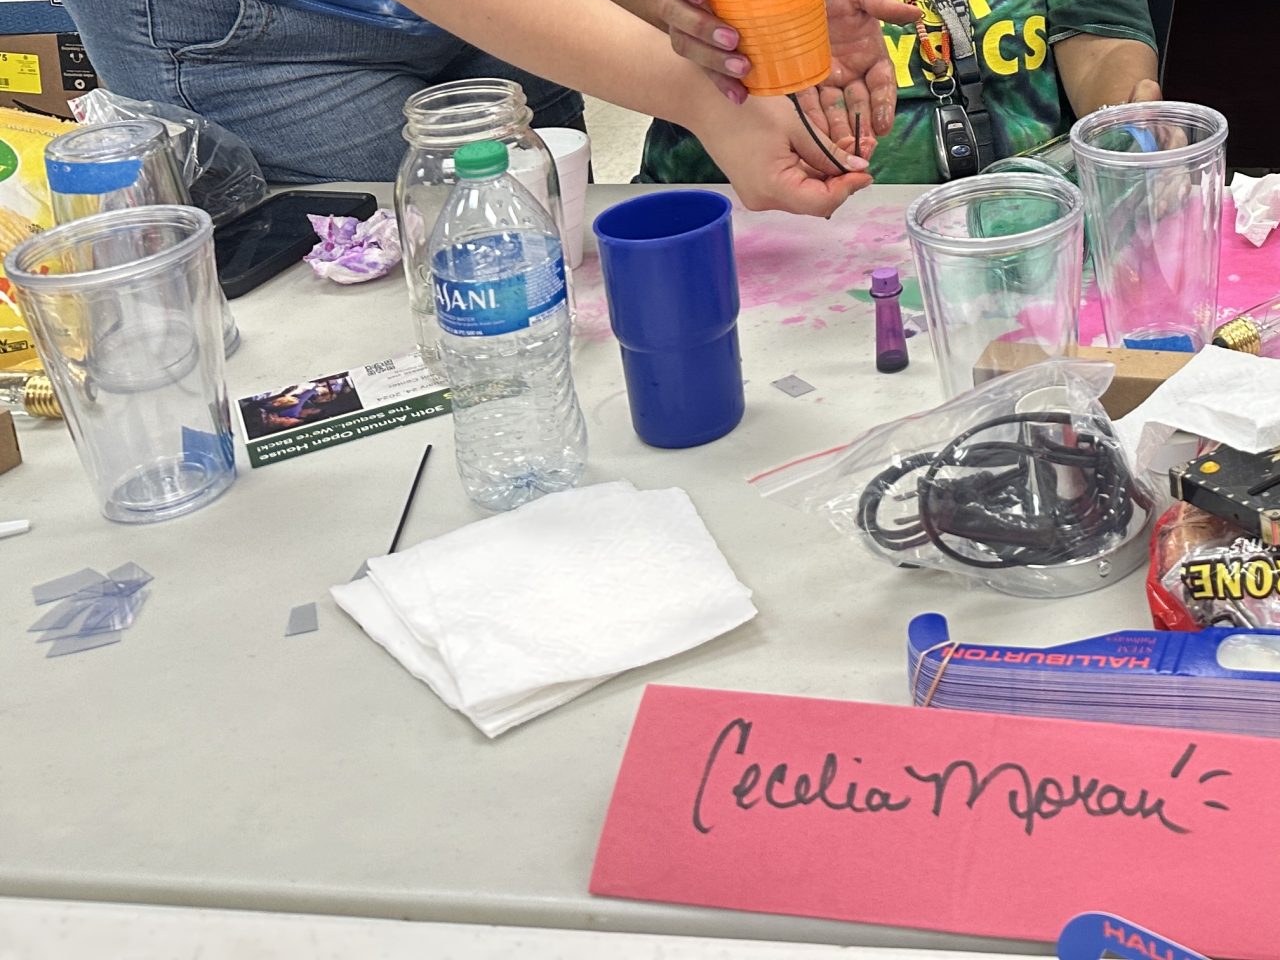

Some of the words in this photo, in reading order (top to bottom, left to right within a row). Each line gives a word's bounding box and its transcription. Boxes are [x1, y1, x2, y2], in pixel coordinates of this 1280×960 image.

[436, 282, 497, 312] ASANI
[388, 405, 412, 415] The
[410, 404, 445, 418] 30th
[357, 415, 407, 434] Annual
[256, 436, 293, 453] Back!
[312, 429, 354, 446] Open
[259, 442, 310, 461] House
[941, 646, 1150, 669] HALLIBURTON
[1116, 644, 1153, 654] STEM
[694, 718, 912, 833] Cecelia
